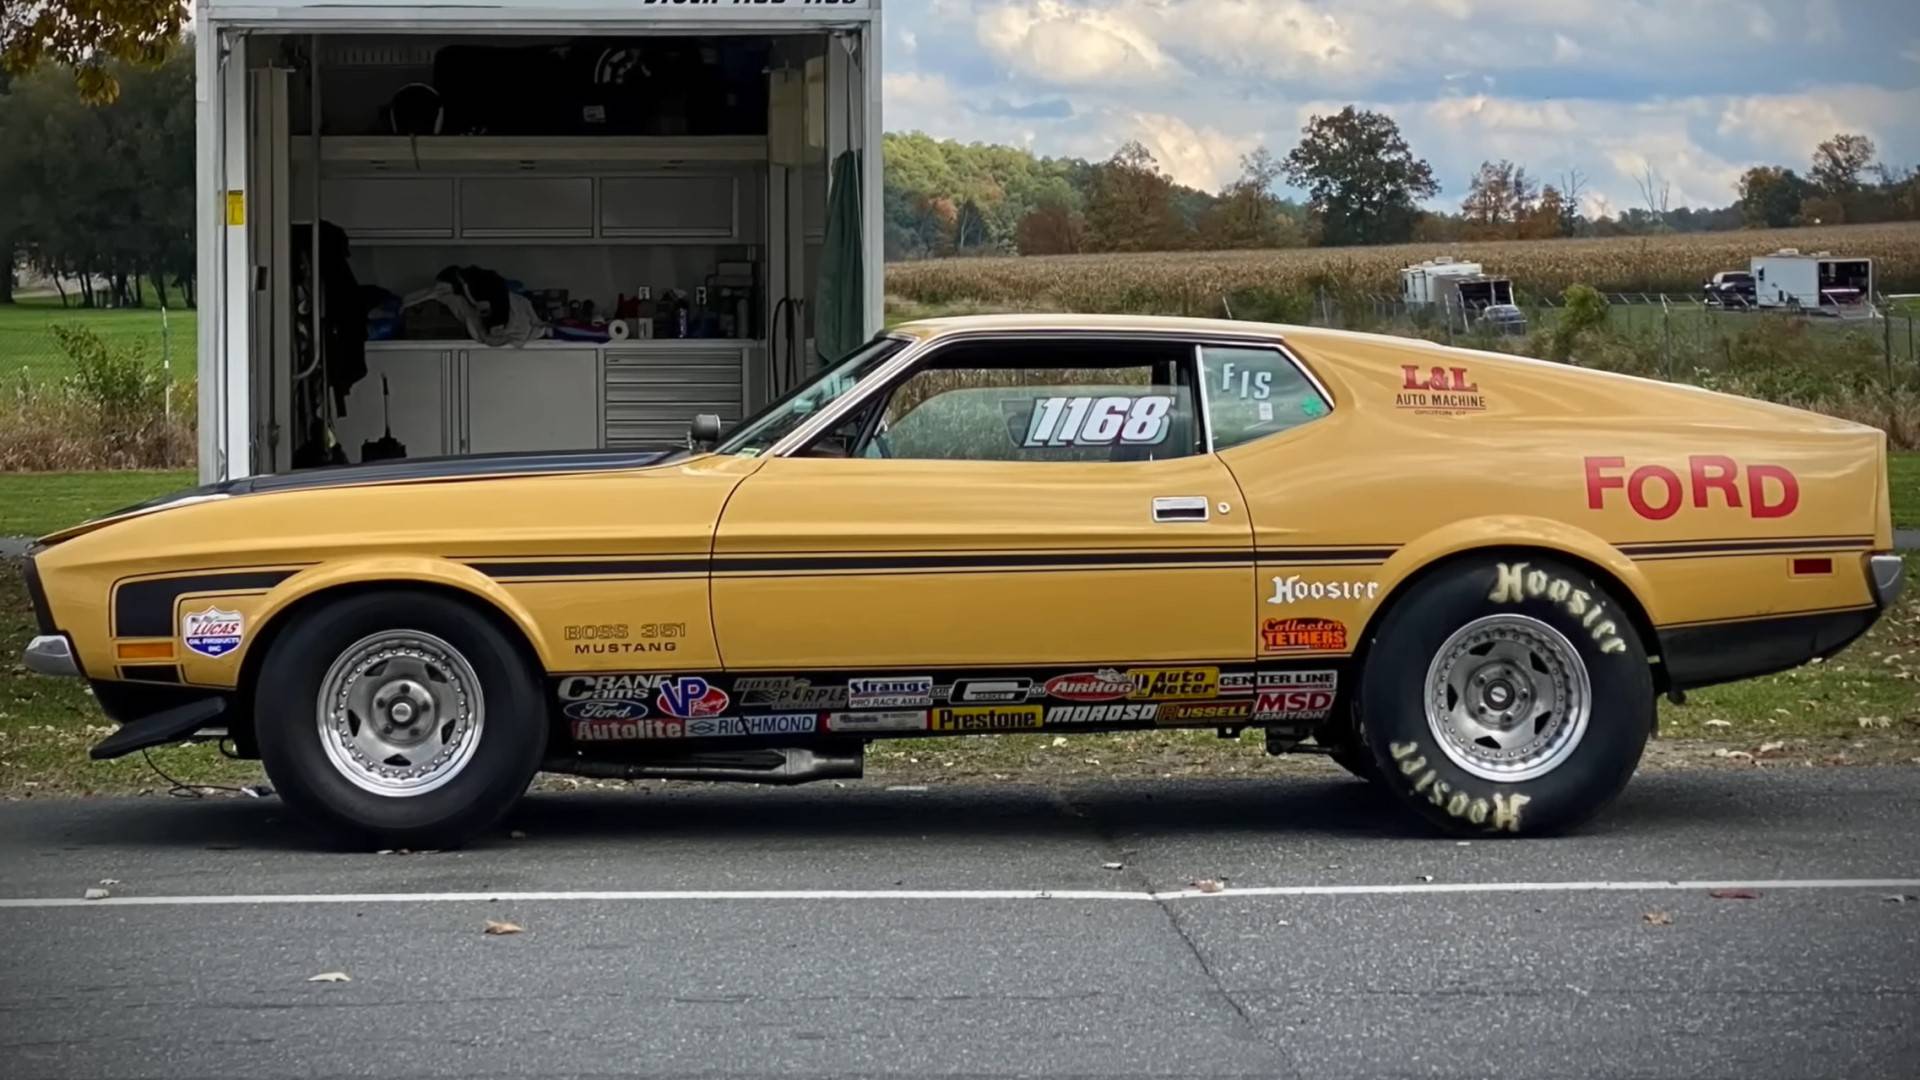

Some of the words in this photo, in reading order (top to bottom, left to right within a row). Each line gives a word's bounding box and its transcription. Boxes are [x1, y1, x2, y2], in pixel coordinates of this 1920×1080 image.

[1401, 364, 1478, 393] L&L
[1396, 393, 1427, 406] AUTO
[1431, 394, 1486, 408] MACHINE
[1025, 396, 1173, 446] 1168
[1584, 455, 1800, 520] FORD
[1267, 574, 1379, 604] Hoosier
[1489, 561, 1627, 655] Hoosier
[193, 622, 240, 636] LUCAS
[564, 624, 630, 640] BOSS
[641, 622, 686, 639] 351
[1264, 631, 1346, 646] TETHERS
[575, 642, 678, 654] MUSTANG
[1154, 670, 1206, 683] Auto
[1220, 674, 1291, 687] CENTER
[1296, 671, 1335, 684] LINE
[850, 680, 931, 694] Strange
[1149, 682, 1216, 696] Meter
[659, 676, 709, 718] VP
[851, 699, 871, 707] PRO
[873, 698, 899, 706] RACE
[1256, 691, 1334, 712] MSD
[580, 701, 632, 719] Ford
[939, 708, 1037, 730] Prestone
[1159, 702, 1250, 720] RUSSELL
[1254, 711, 1326, 721] IGNITION
[575, 720, 683, 741] Autolite
[718, 715, 814, 735] RICHMOND
[1389, 741, 1532, 832] Hoosier
